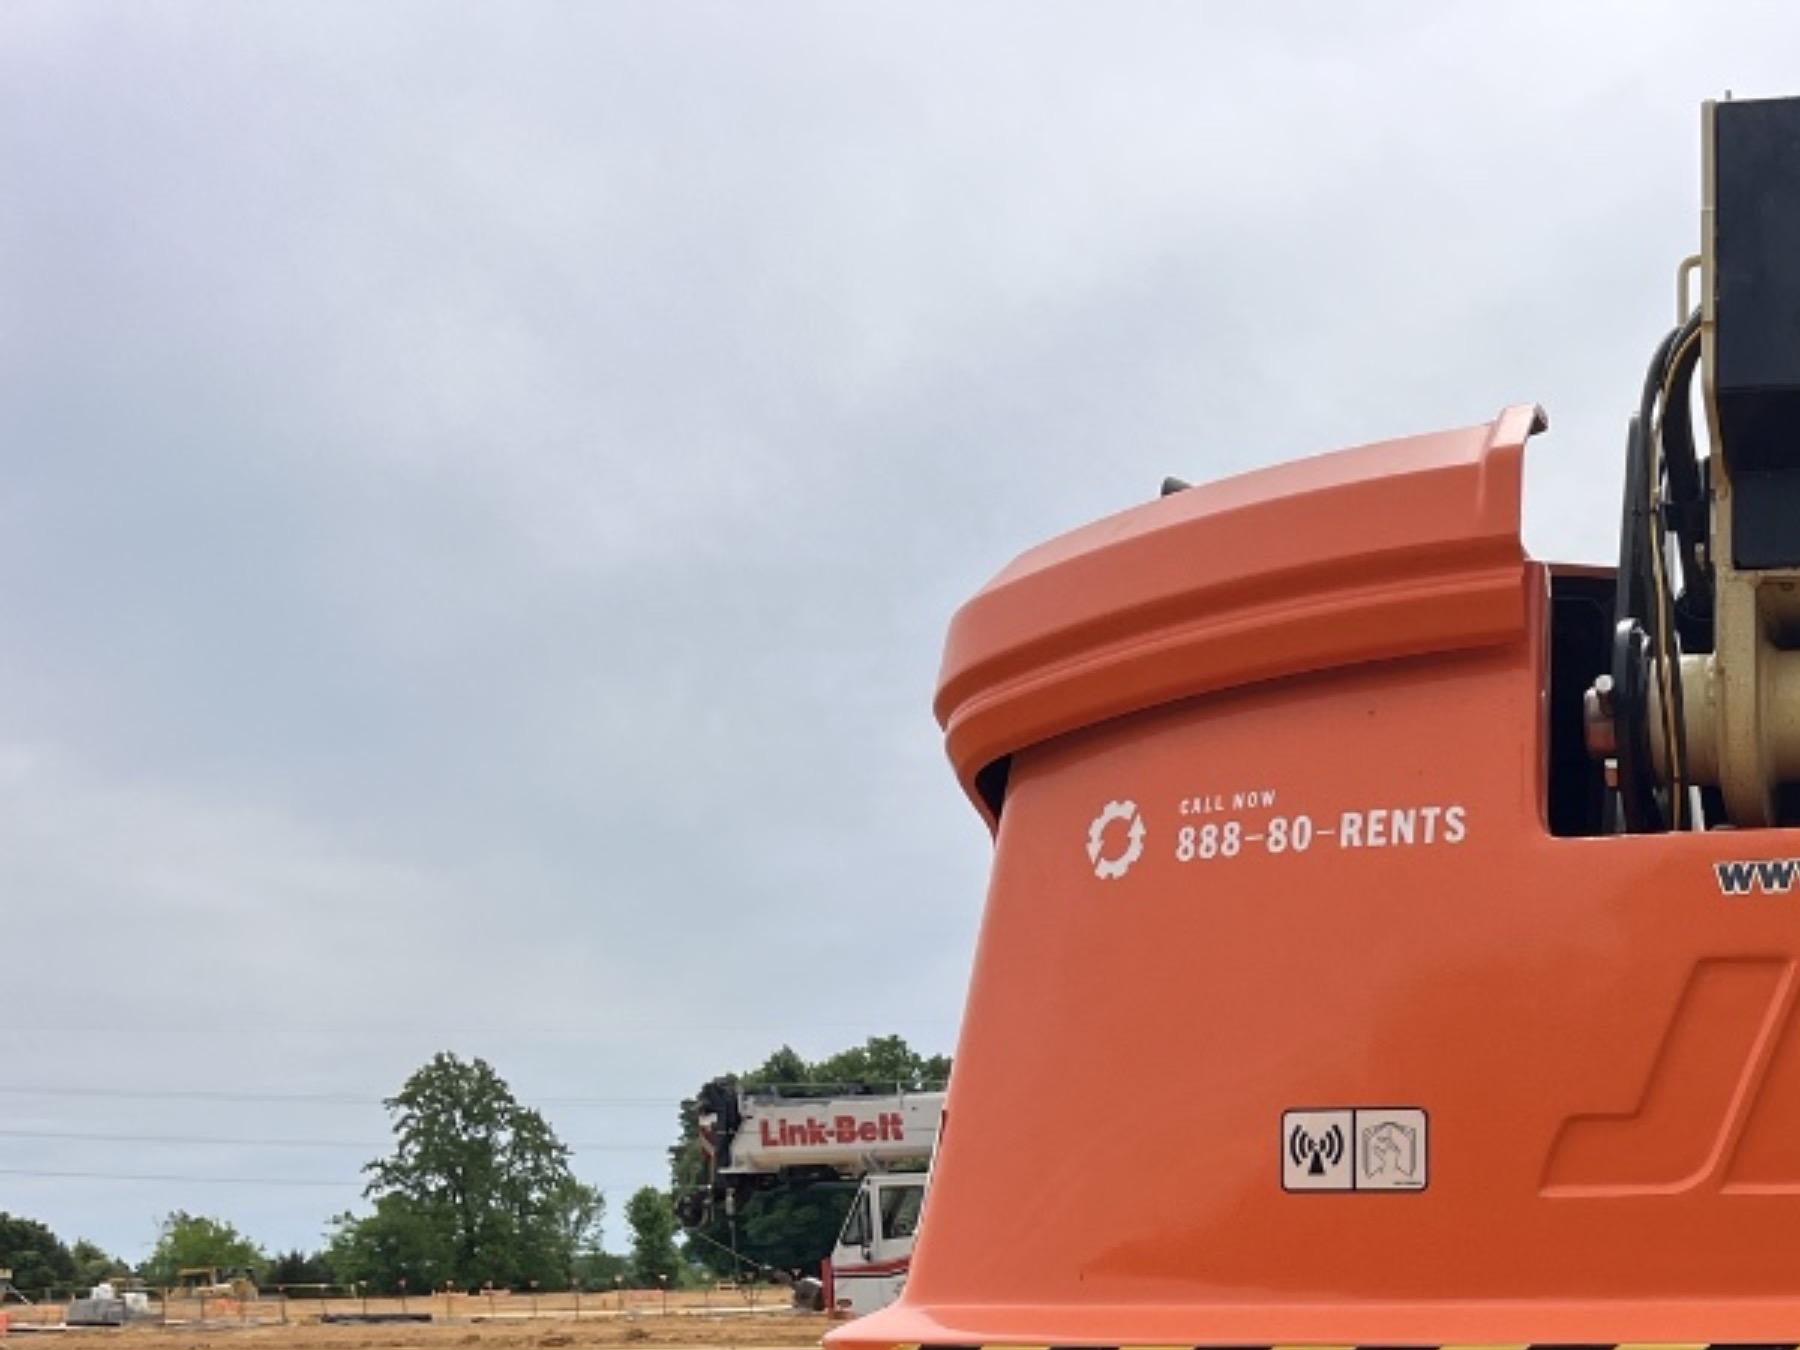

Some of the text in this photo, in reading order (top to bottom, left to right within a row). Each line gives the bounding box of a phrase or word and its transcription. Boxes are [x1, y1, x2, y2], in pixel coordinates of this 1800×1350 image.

[1178, 790, 1277, 816] CALL NOW
[1175, 805, 1468, 863] 888-80-RENTS
[758, 1112, 905, 1148] Link-Belt
